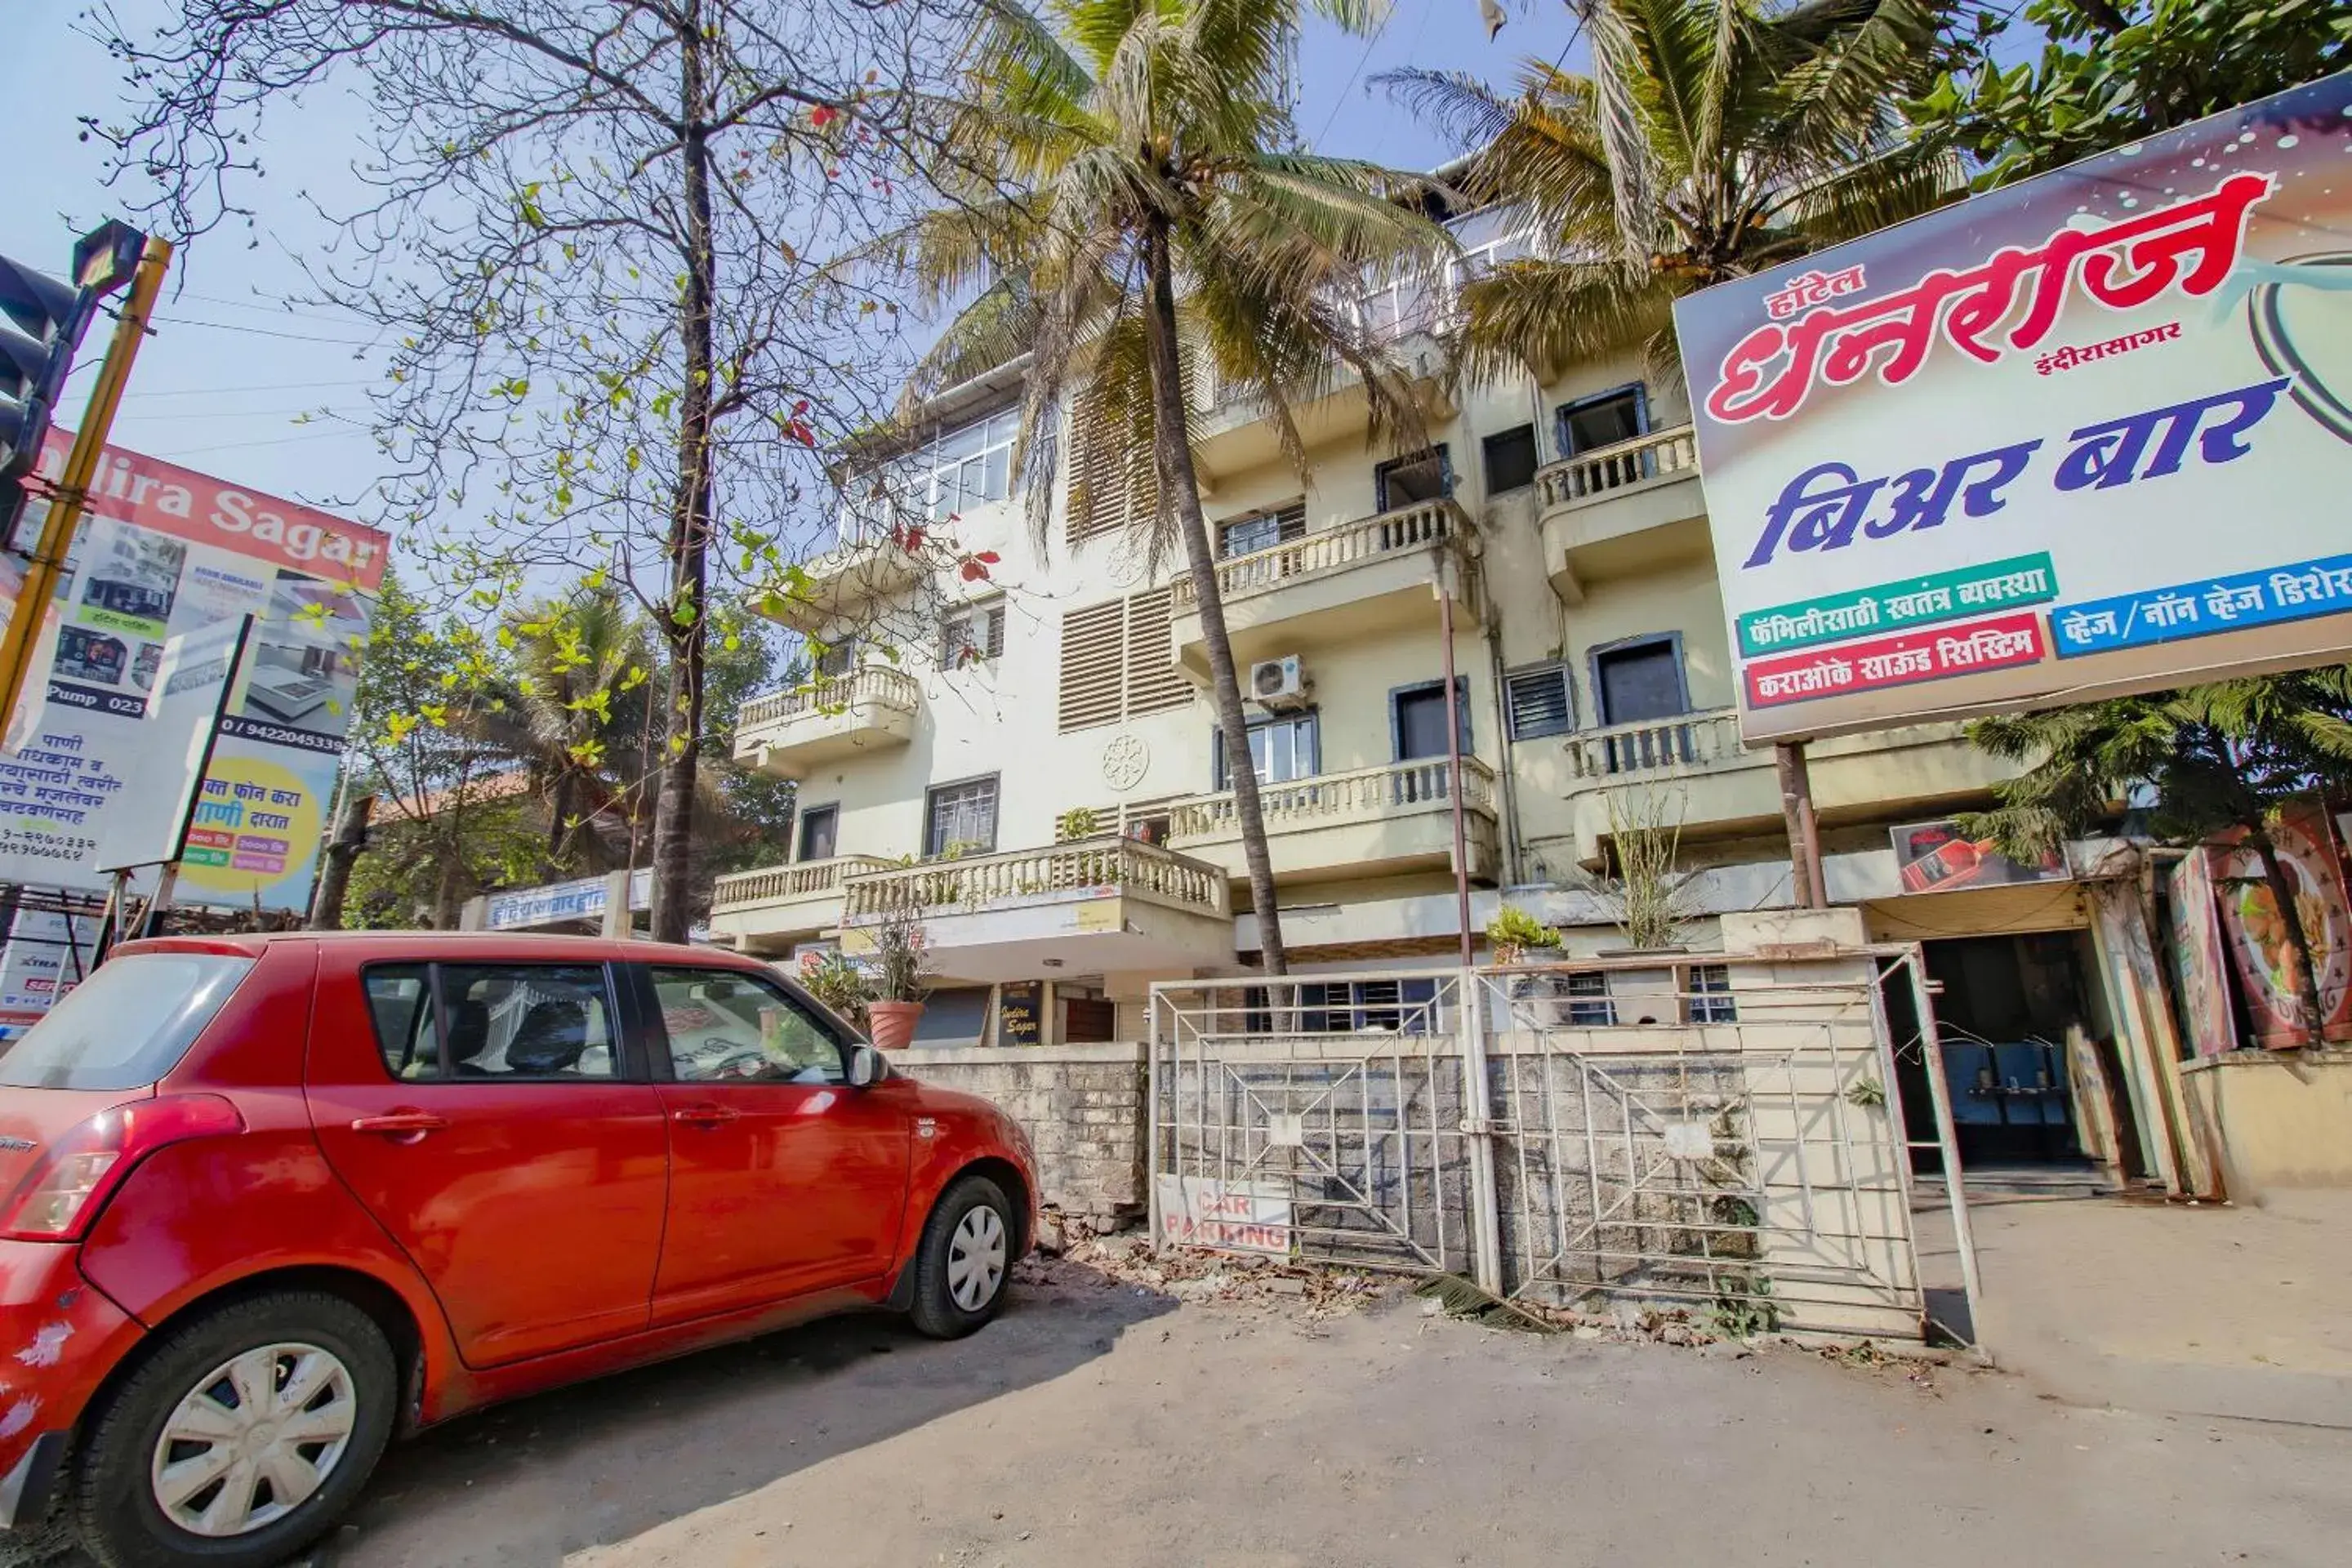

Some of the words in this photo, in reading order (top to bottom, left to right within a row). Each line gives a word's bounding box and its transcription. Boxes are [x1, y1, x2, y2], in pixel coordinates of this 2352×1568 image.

[1708, 173, 2274, 421] धनराज
[1766, 265, 1865, 318] हॉटेल
[2033, 321, 2182, 376] इंदीरासागर
[1742, 439, 2044, 569] बिअर
[2054, 377, 2291, 491] बार
[210, 489, 381, 569] Sagar
[1884, 581, 1951, 621] स्वतंत्र
[1958, 568, 2049, 605] व्यवस्था
[2061, 609, 2118, 644] व्हेज
[2141, 591, 2200, 627] नॉन
[2203, 583, 2265, 621] व्हेज
[1757, 656, 1853, 698] कराओके
[1859, 642, 1932, 680] साऊंड
[1936, 628, 2034, 669] सिस्टिम
[47, 685, 98, 706] Pump
[109, 697, 144, 713] 023
[42, 734, 83, 751] पाणी
[90, 759, 105, 773] व
[203, 778, 229, 797] क्त
[234, 780, 267, 802] फोन
[271, 788, 301, 808] करा
[250, 810, 289, 830] दारात
[1196, 1191, 1251, 1215] CAR
[1165, 1211, 1285, 1249] PARKING
